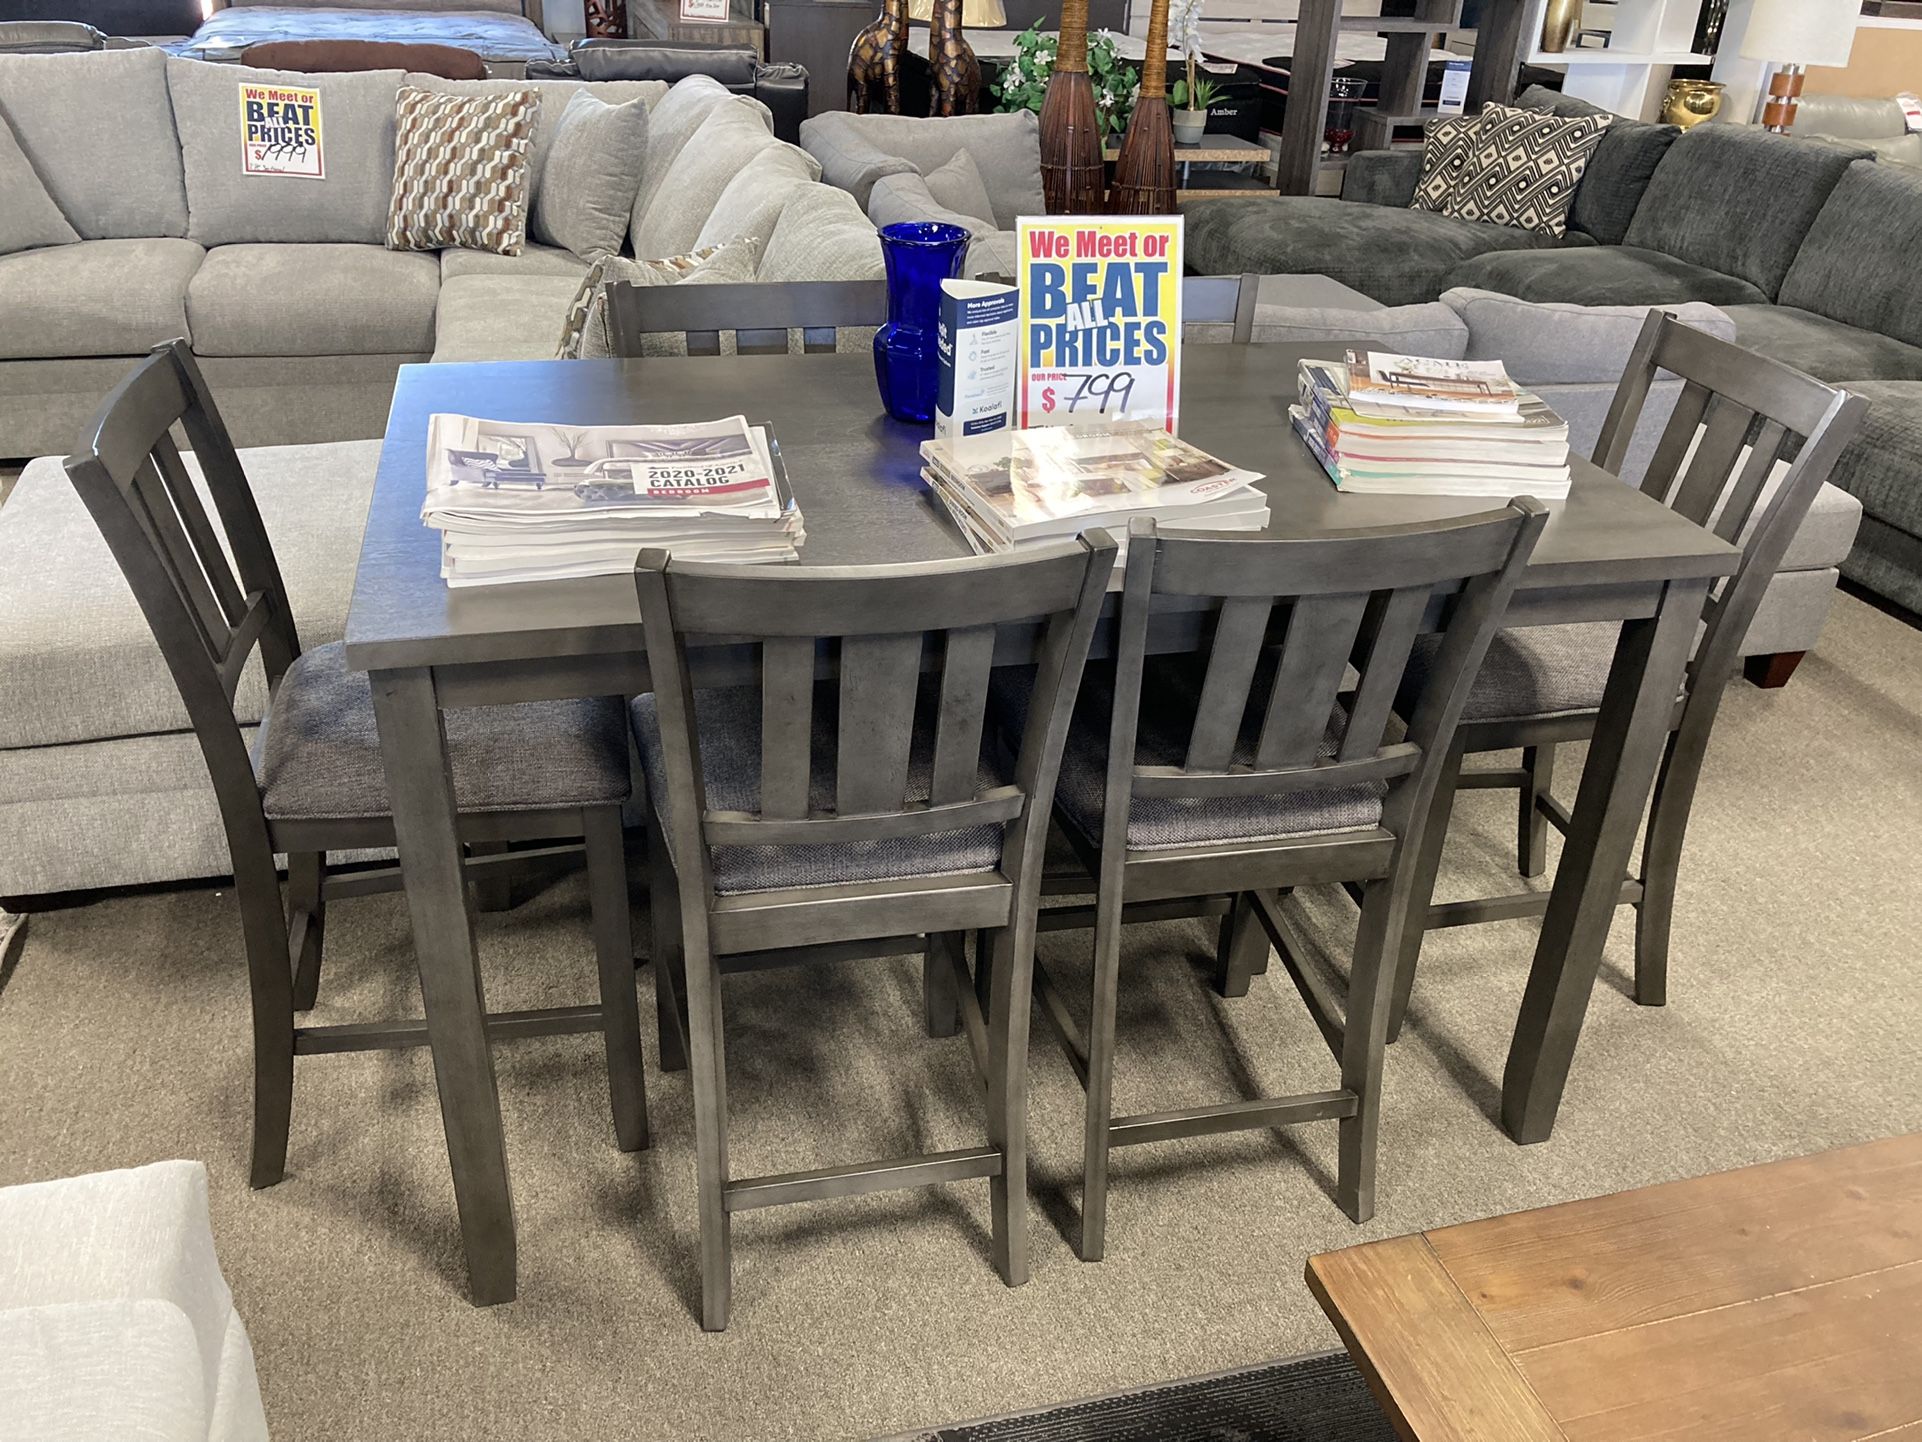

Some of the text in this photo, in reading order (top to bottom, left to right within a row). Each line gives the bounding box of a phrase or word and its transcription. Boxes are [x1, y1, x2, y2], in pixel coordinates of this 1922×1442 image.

[246, 88, 314, 103] We Meet or
[246, 100, 314, 126] BEAT
[1210, 108, 1238, 116] Amber
[247, 123, 316, 146] PRICES
[1029, 230, 1169, 258] We Meet or
[1029, 261, 1168, 319] BEAT
[1065, 297, 1109, 332] ALL
[1029, 320, 1167, 368] PRICES
[1031, 373, 1067, 382] OUR PRICE
[1041, 386, 1056, 414] $
[1064, 371, 1136, 414] 799
[648, 463, 746, 479] 2020-2021
[650, 475, 730, 488] CATALOG
